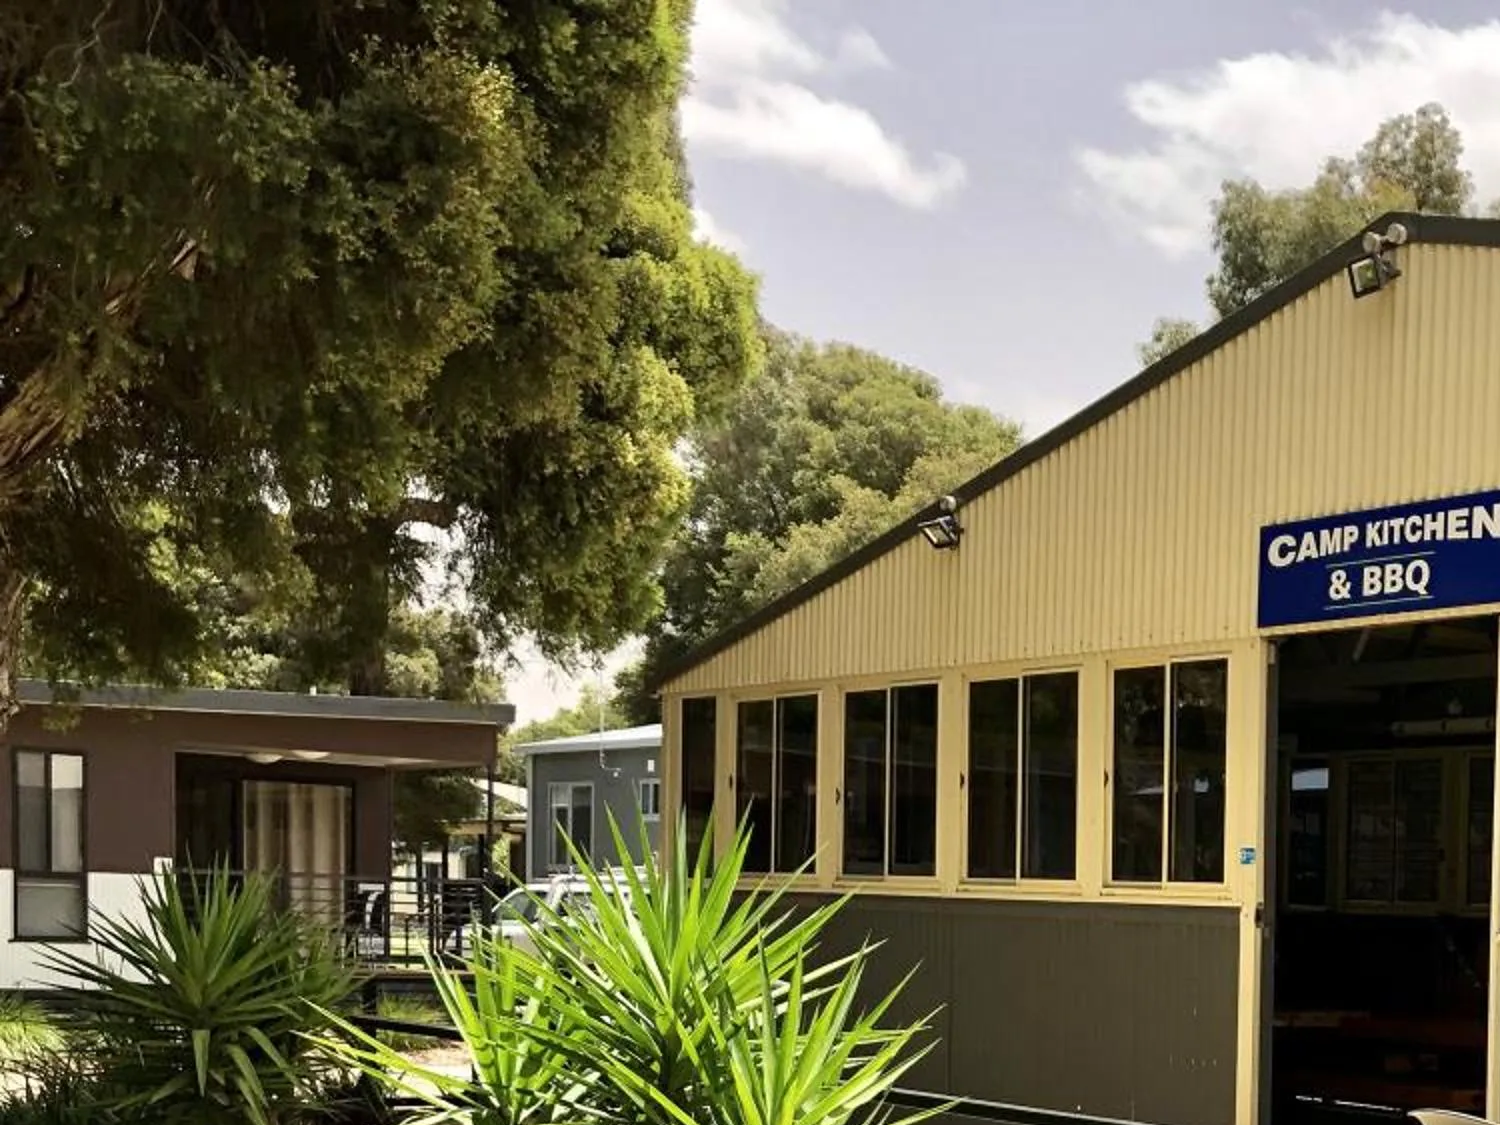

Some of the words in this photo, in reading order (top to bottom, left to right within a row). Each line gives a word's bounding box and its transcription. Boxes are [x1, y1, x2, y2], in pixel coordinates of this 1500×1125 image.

[1267, 525, 1359, 567] CAMP
[1328, 569, 1351, 601] &
[1362, 559, 1431, 597] BBQ
